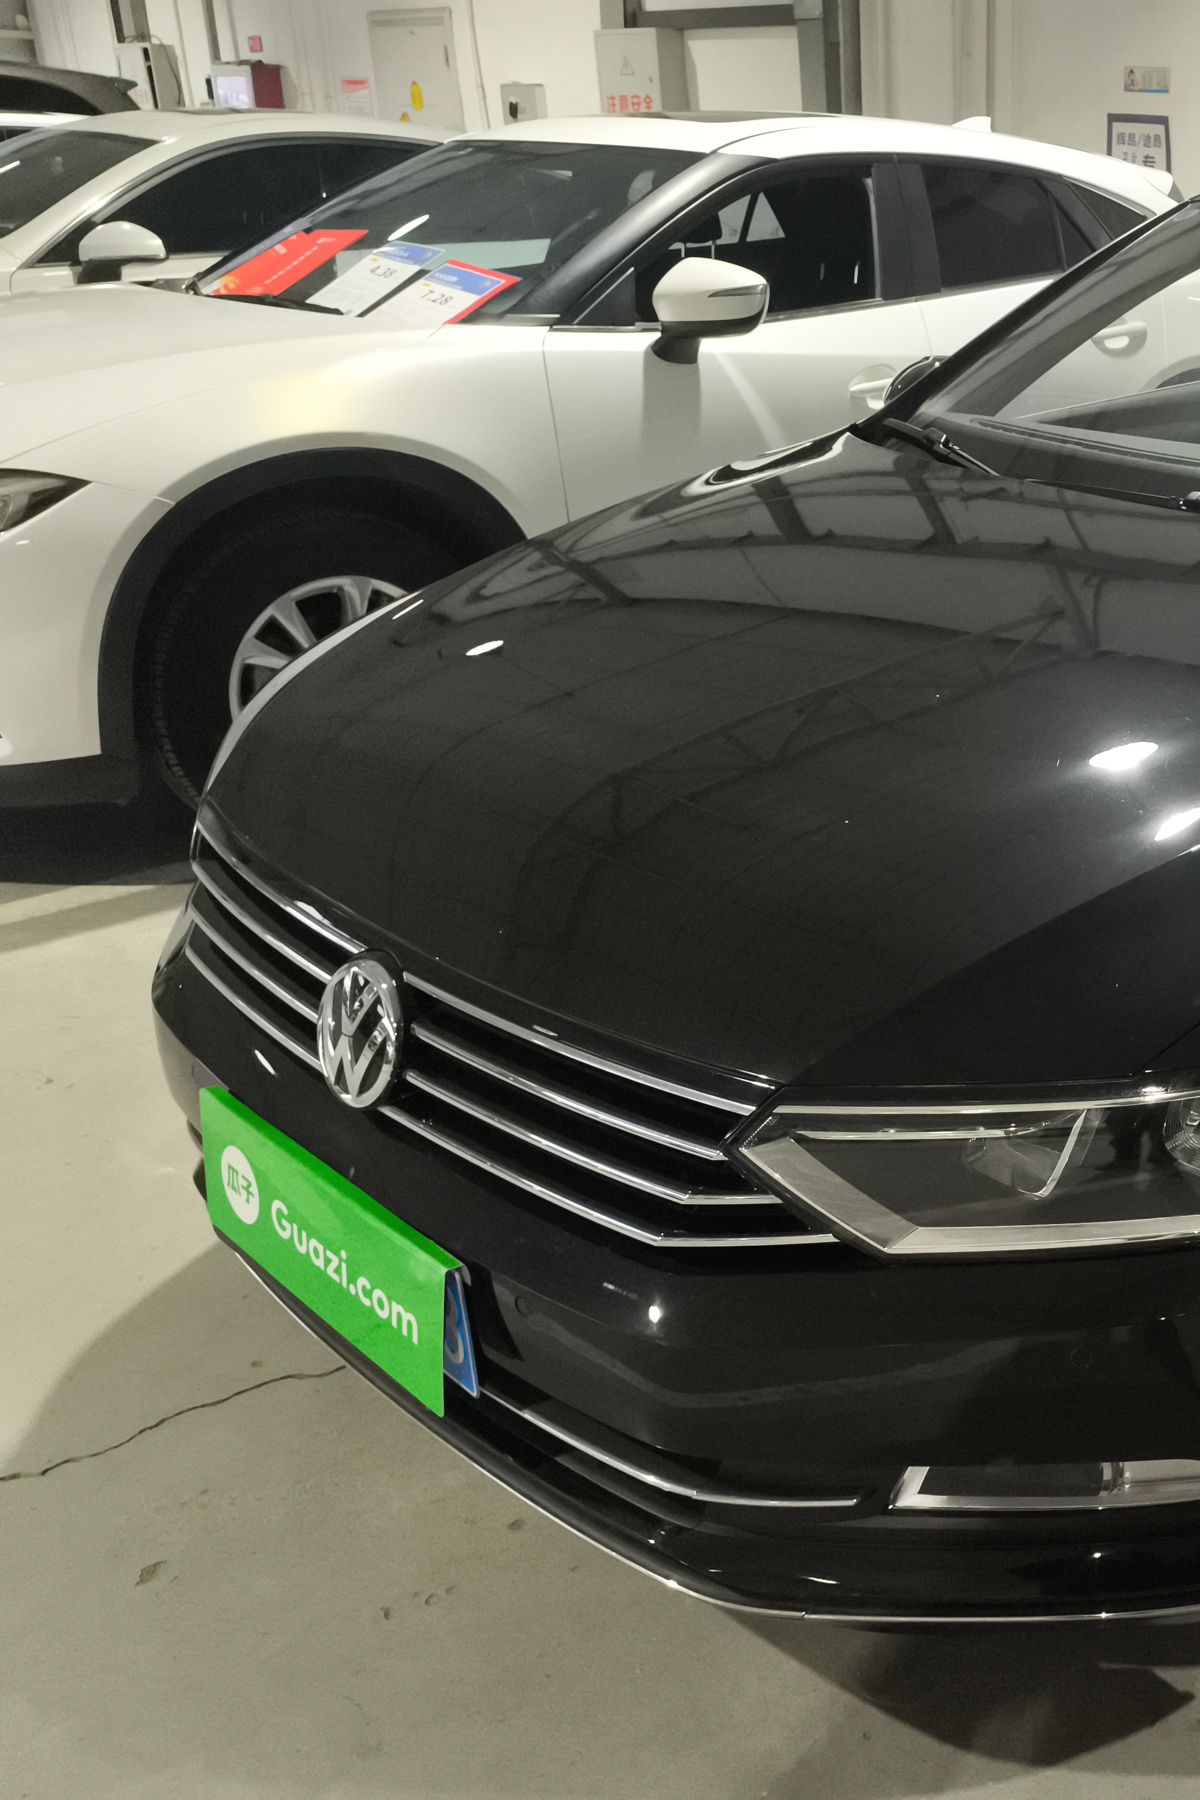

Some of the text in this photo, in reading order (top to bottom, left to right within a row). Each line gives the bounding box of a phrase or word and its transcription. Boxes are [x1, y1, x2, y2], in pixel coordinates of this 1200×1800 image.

[607, 94, 653, 113] 注意安全
[369, 265, 397, 278] 4.38
[420, 289, 454, 305] 7.28
[227, 1163, 255, 1204] 瓜子
[271, 1199, 420, 1345] Guazi.com
